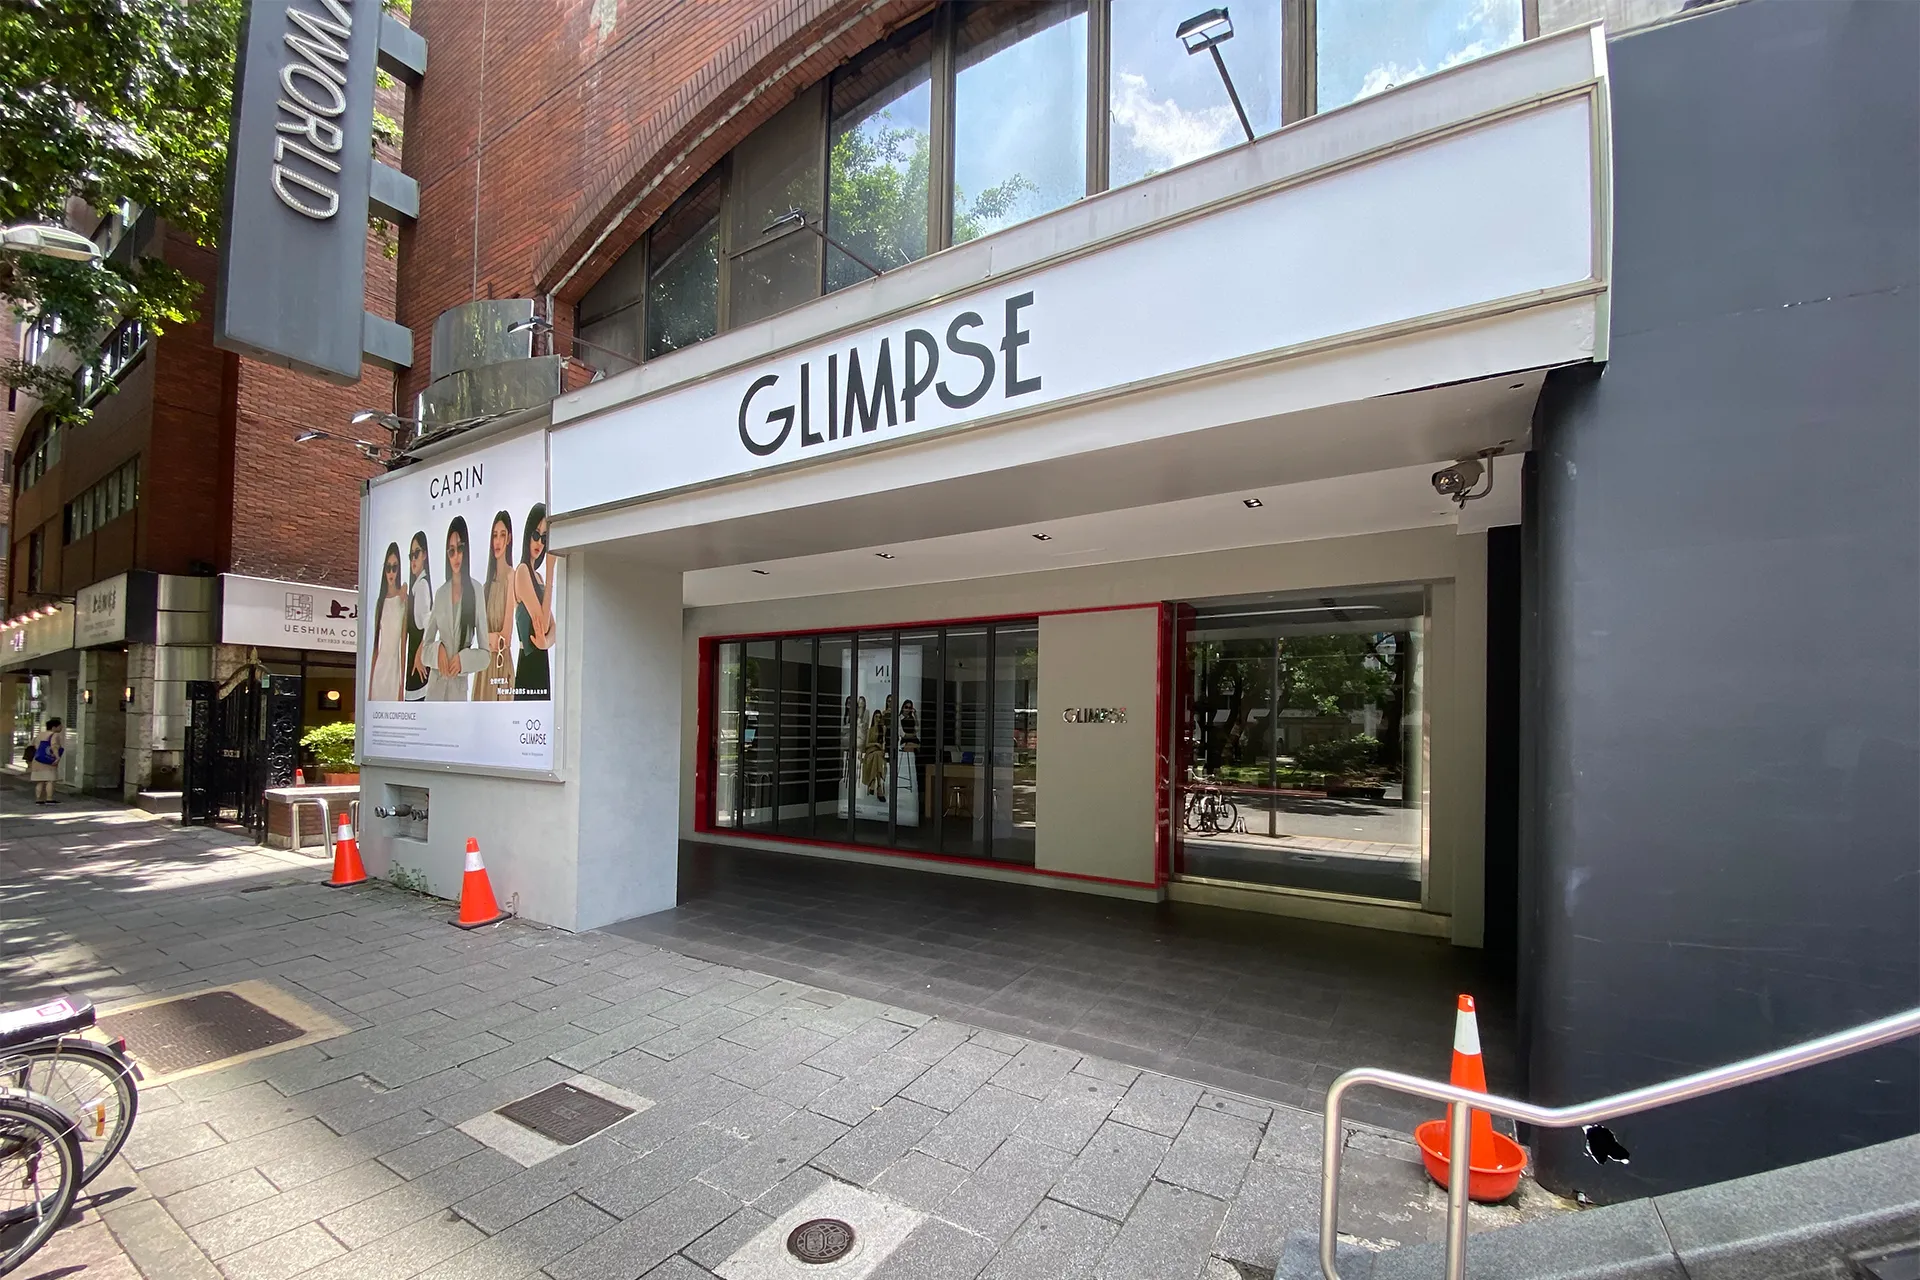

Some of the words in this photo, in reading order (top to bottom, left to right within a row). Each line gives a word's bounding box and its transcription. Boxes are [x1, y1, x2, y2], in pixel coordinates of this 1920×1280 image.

[738, 290, 1042, 457] GLIMPSE
[430, 463, 483, 499] CARIN
[284, 624, 336, 637] UESHIMA
[497, 687, 526, 695] NewJeans
[372, 711, 384, 719] LOOK
[389, 711, 416, 720] CONFIDENCE
[1062, 707, 1128, 724] GLIMPSE
[519, 733, 547, 745] GLIMPSE
